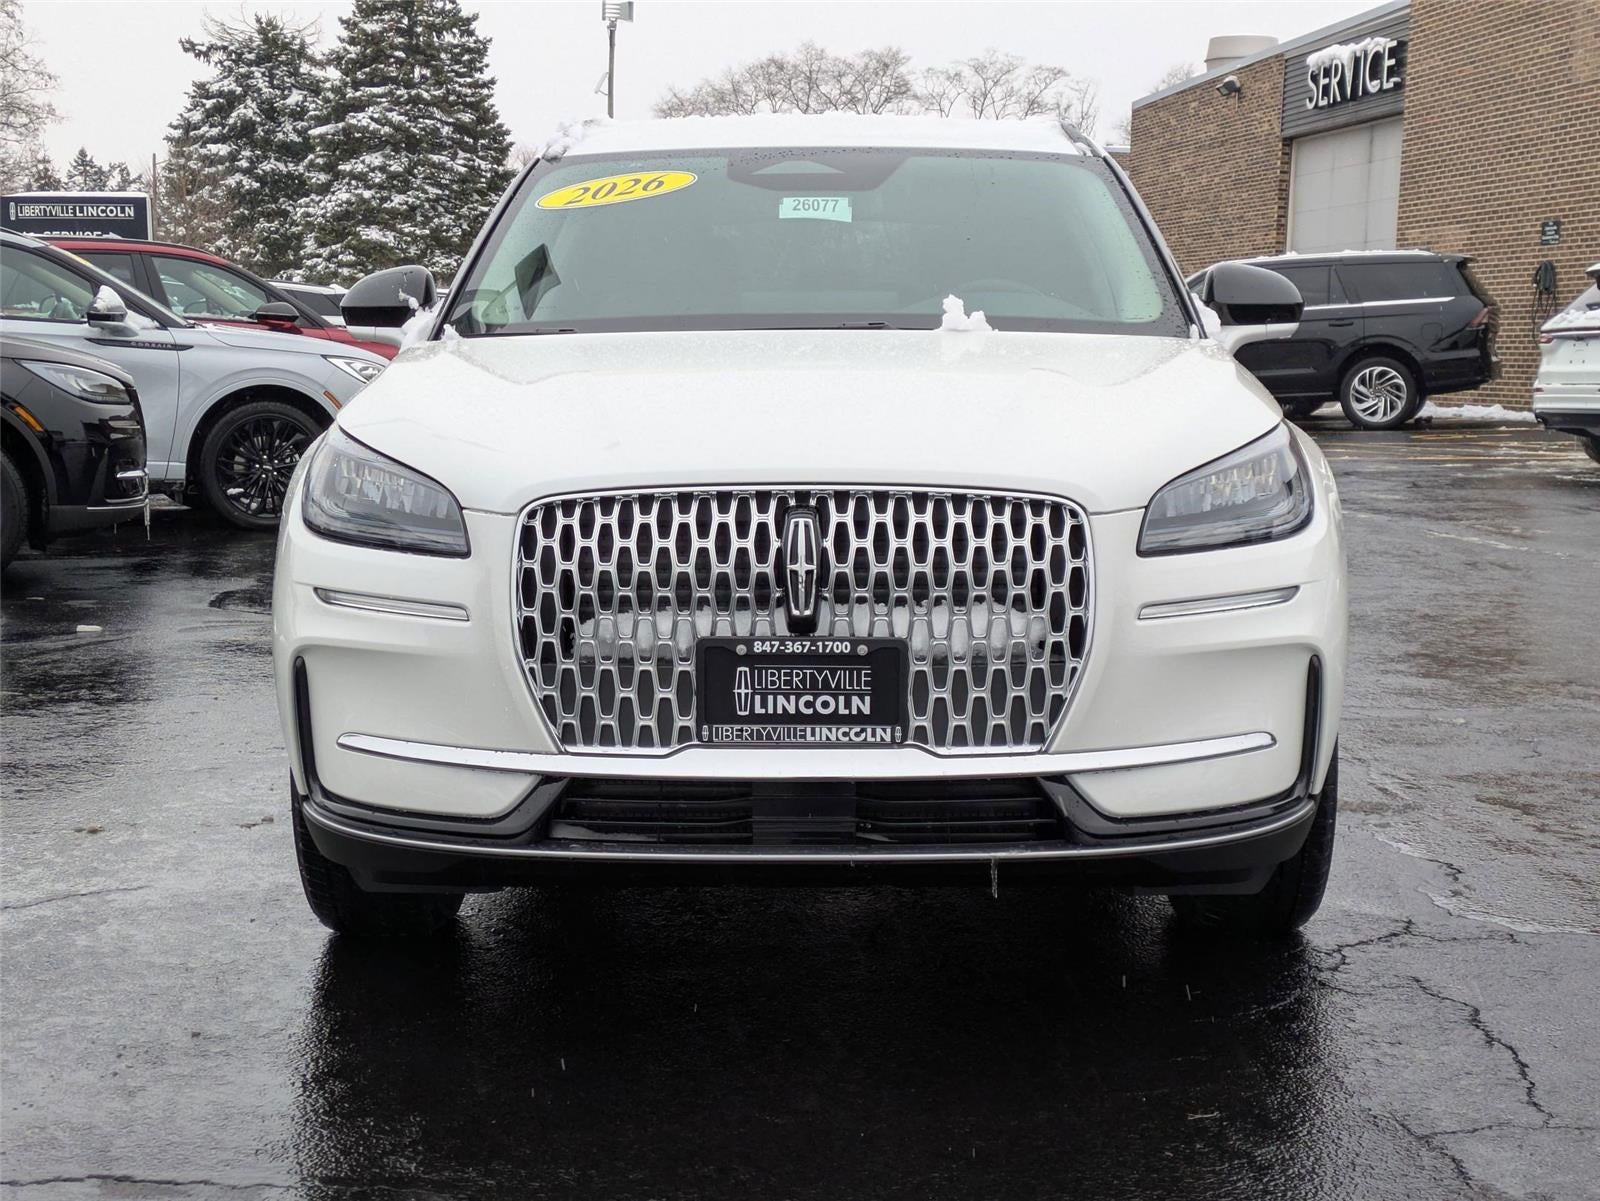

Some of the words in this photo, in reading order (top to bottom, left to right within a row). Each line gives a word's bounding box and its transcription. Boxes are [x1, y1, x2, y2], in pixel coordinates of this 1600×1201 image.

[1306, 40, 1398, 109] SERVICE
[563, 174, 670, 206] 2026
[17, 205, 74, 217] LIBERTYVILLE
[75, 206, 135, 217] LINCOLN
[792, 198, 839, 212] 26077
[753, 641, 851, 653] 847-367-1700
[754, 669, 872, 690] LIBERTYVILLE
[754, 695, 871, 715] LINCOLN
